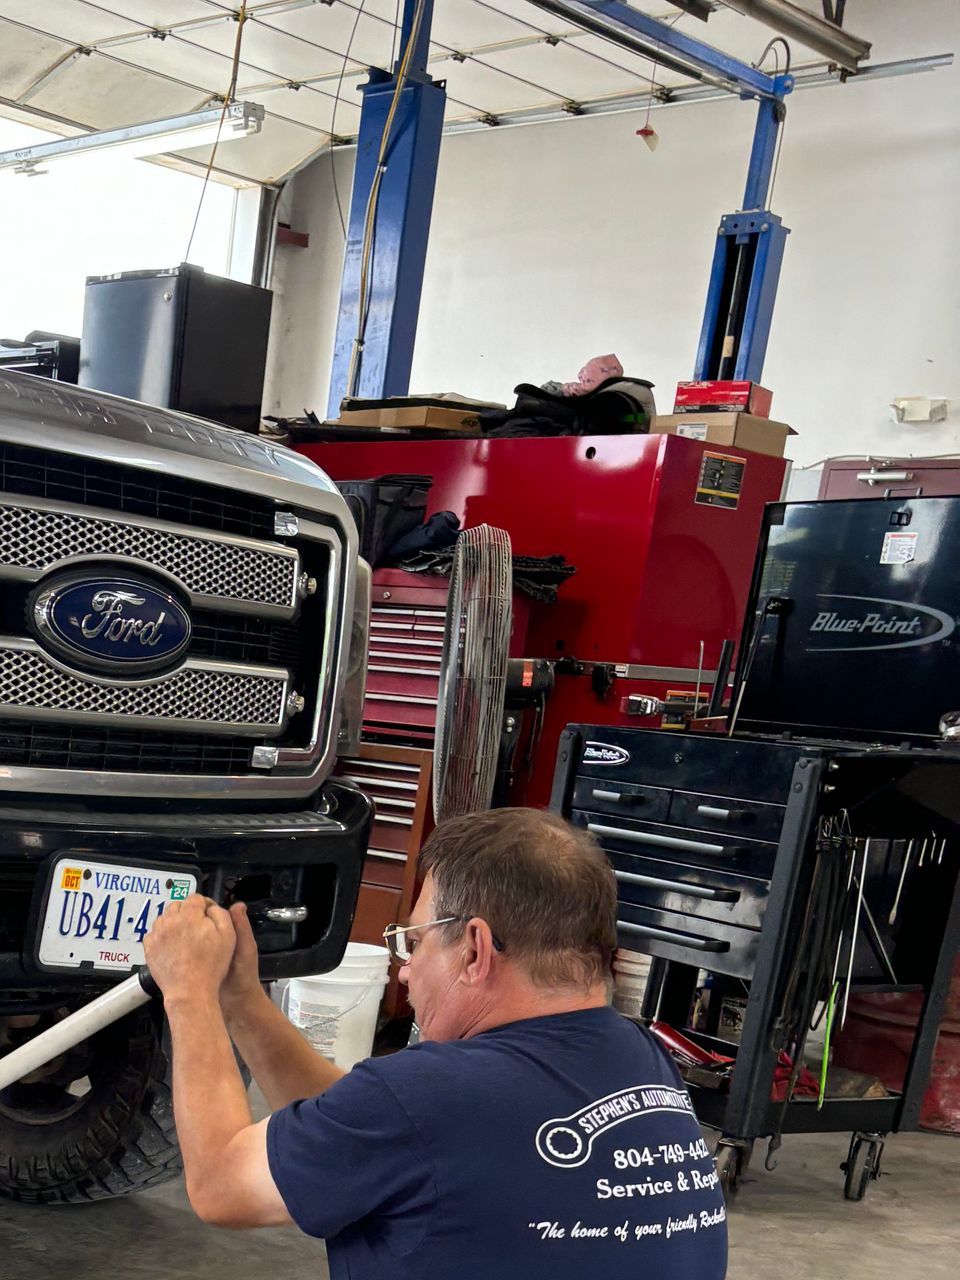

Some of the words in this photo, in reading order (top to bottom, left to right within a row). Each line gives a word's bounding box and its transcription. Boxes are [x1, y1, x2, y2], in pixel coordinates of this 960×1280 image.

[81, 590, 166, 647] Ford
[809, 612, 920, 634] Blue-Point
[65, 874, 80, 889] OCT
[95, 871, 161, 896] VIRGINIA
[173, 887, 188, 899] 24
[99, 951, 130, 963] TRUCK
[578, 1092, 641, 1134] STEPHEN'S
[640, 1089, 693, 1110] AUTOMOTIVE
[596, 1176, 674, 1199] Service
[677, 1171, 691, 1192] &
[570, 1220, 609, 1239] home
[614, 1220, 629, 1242] of
[634, 1222, 663, 1241] your
[665, 1212, 698, 1239] friendly
